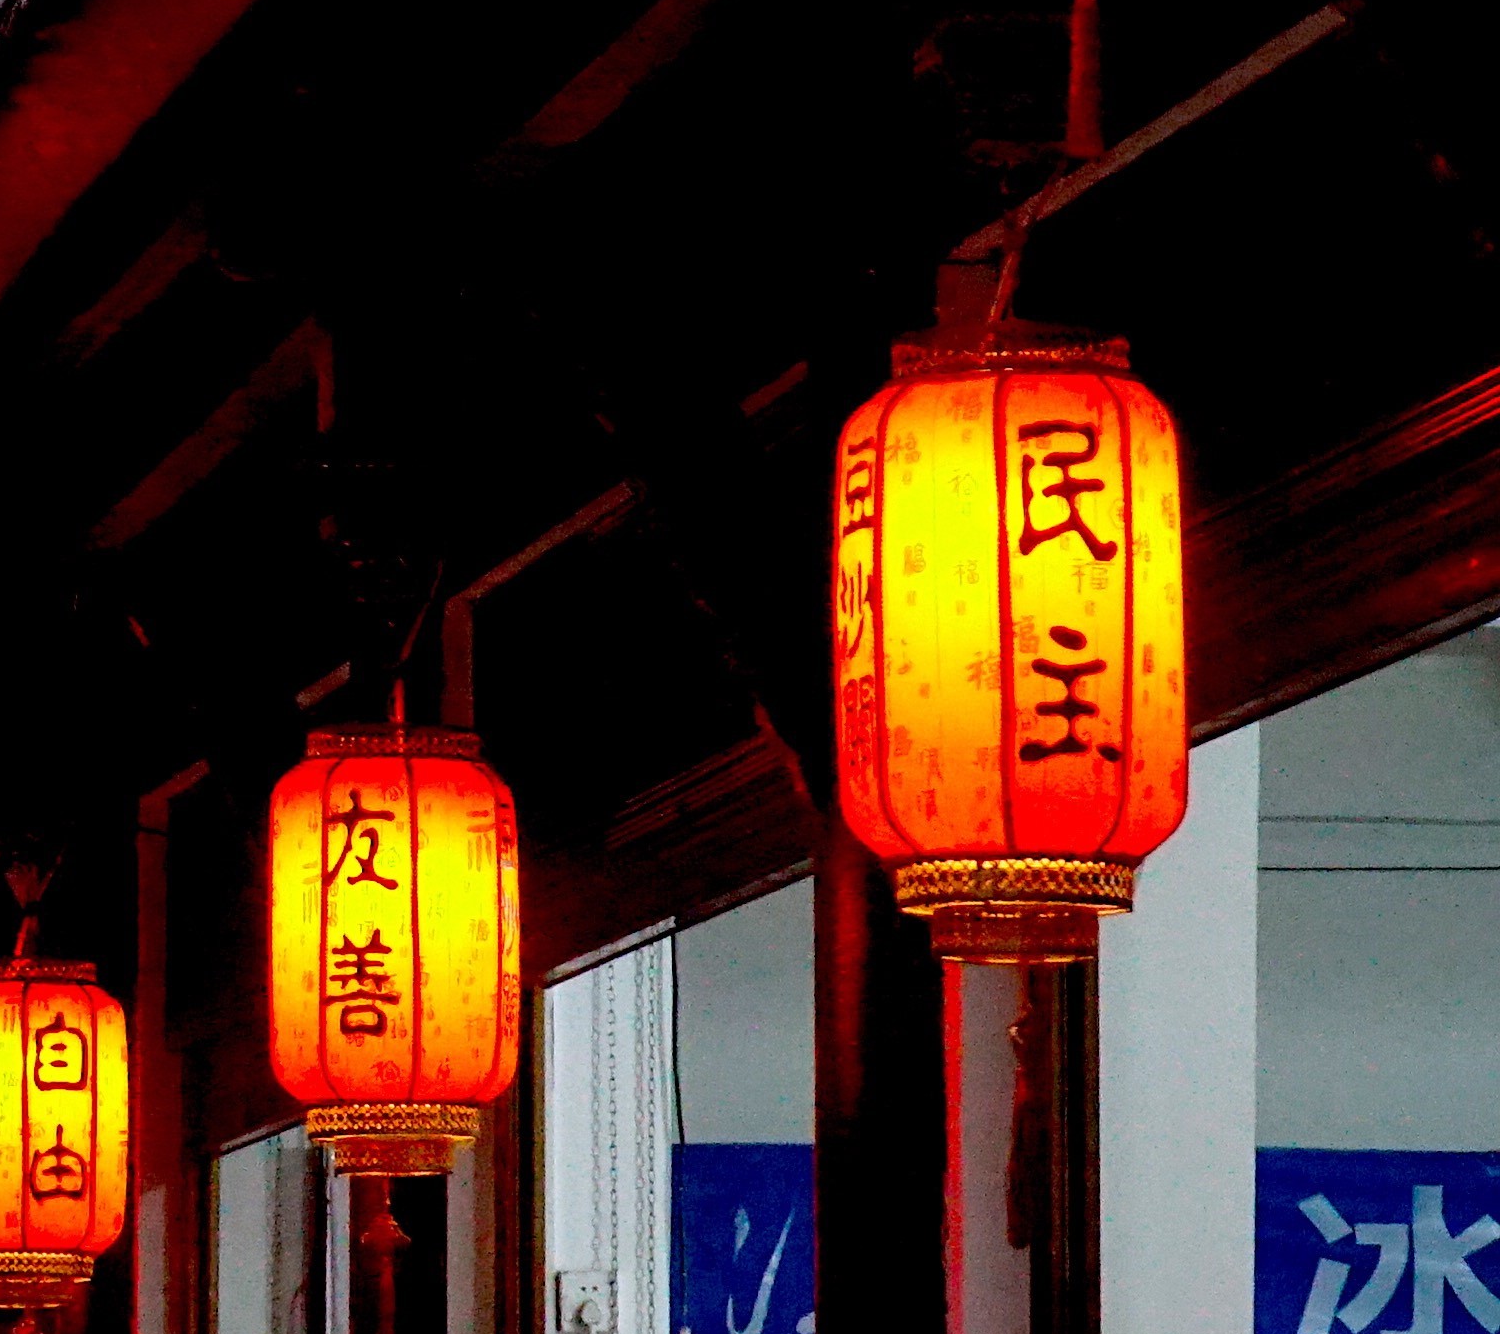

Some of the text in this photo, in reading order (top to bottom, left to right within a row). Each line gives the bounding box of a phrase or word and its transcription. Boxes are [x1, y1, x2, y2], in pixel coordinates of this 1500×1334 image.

[1019, 420, 1122, 762] 民主
[326, 790, 400, 1037] 友善
[30, 1012, 87, 1200] 自由
